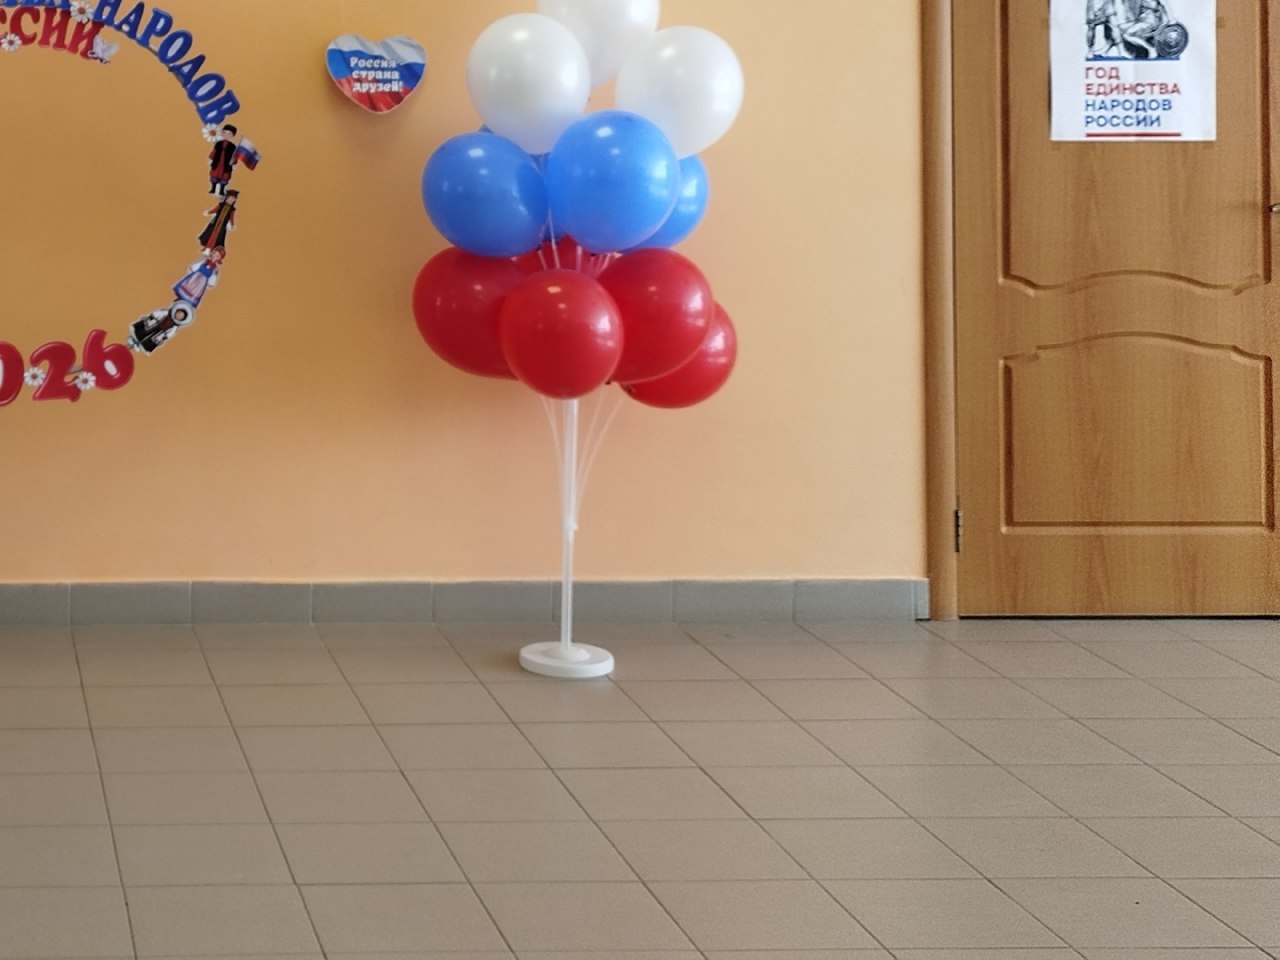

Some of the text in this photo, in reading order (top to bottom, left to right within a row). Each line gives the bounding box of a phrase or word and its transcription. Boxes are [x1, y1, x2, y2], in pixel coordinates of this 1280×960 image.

[349, 56, 397, 68] Россия
[352, 70, 400, 81] страна
[1085, 67, 1120, 79] ГОД
[352, 80, 404, 93] друзей!
[1085, 83, 1181, 95] ЕДИНСТВА
[1085, 99, 1173, 112] НАРОДОВ
[1085, 115, 1161, 128] РОССИИ
